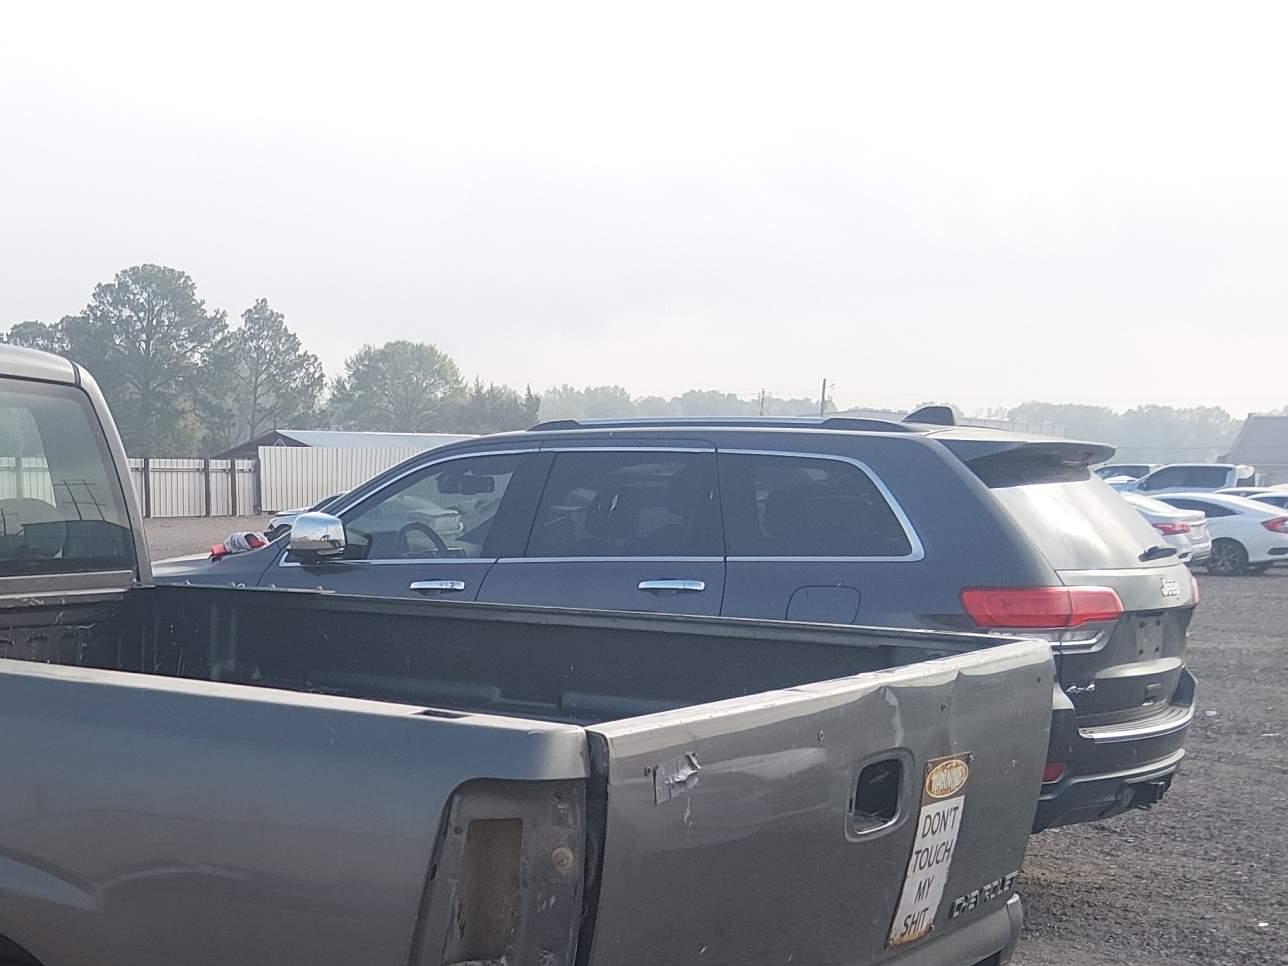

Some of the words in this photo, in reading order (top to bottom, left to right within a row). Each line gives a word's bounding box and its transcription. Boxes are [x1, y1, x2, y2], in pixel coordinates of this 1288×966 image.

[922, 806, 959, 838] DON'T
[913, 841, 953, 872] TOUCH
[914, 877, 934, 903] MY
[902, 908, 929, 937] SHIT
